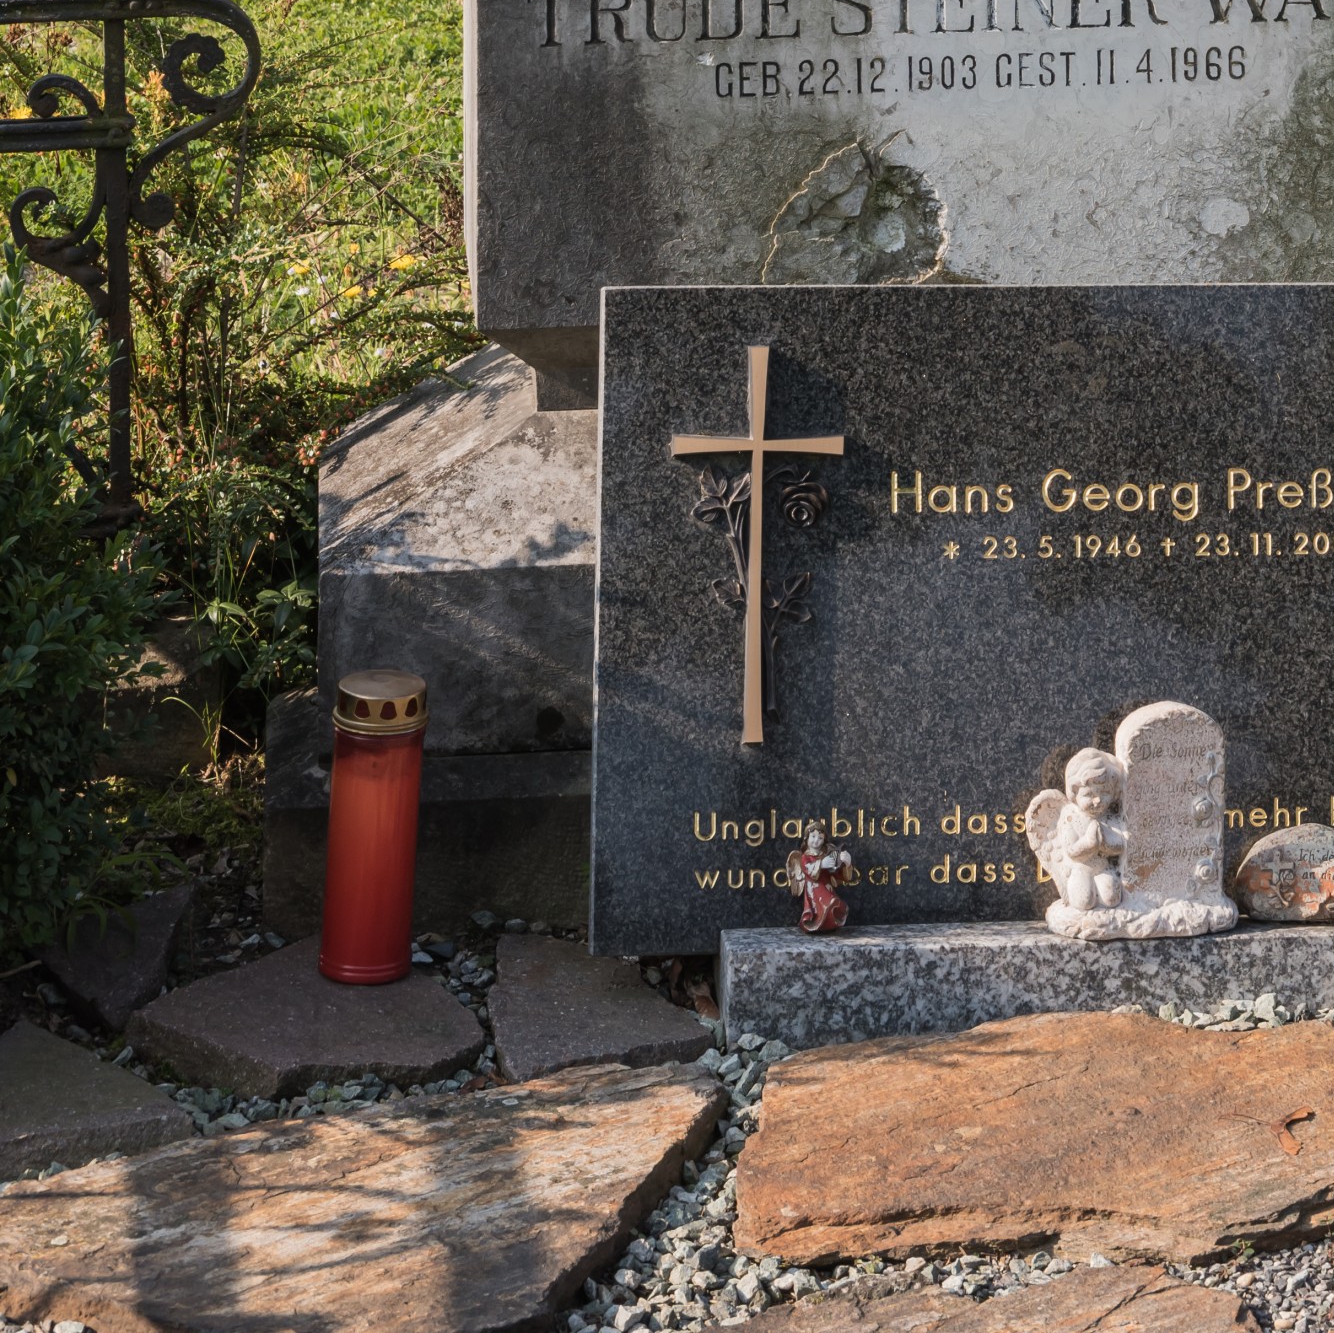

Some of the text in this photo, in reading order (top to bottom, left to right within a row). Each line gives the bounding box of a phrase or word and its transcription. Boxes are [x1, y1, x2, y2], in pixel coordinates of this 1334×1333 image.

[889, 469, 1013, 514] Hans
[1041, 467, 1201, 522] Georg
[693, 804, 921, 847] Unglablich
[940, 804, 1027, 836] dass
[929, 853, 1016, 885] dass
